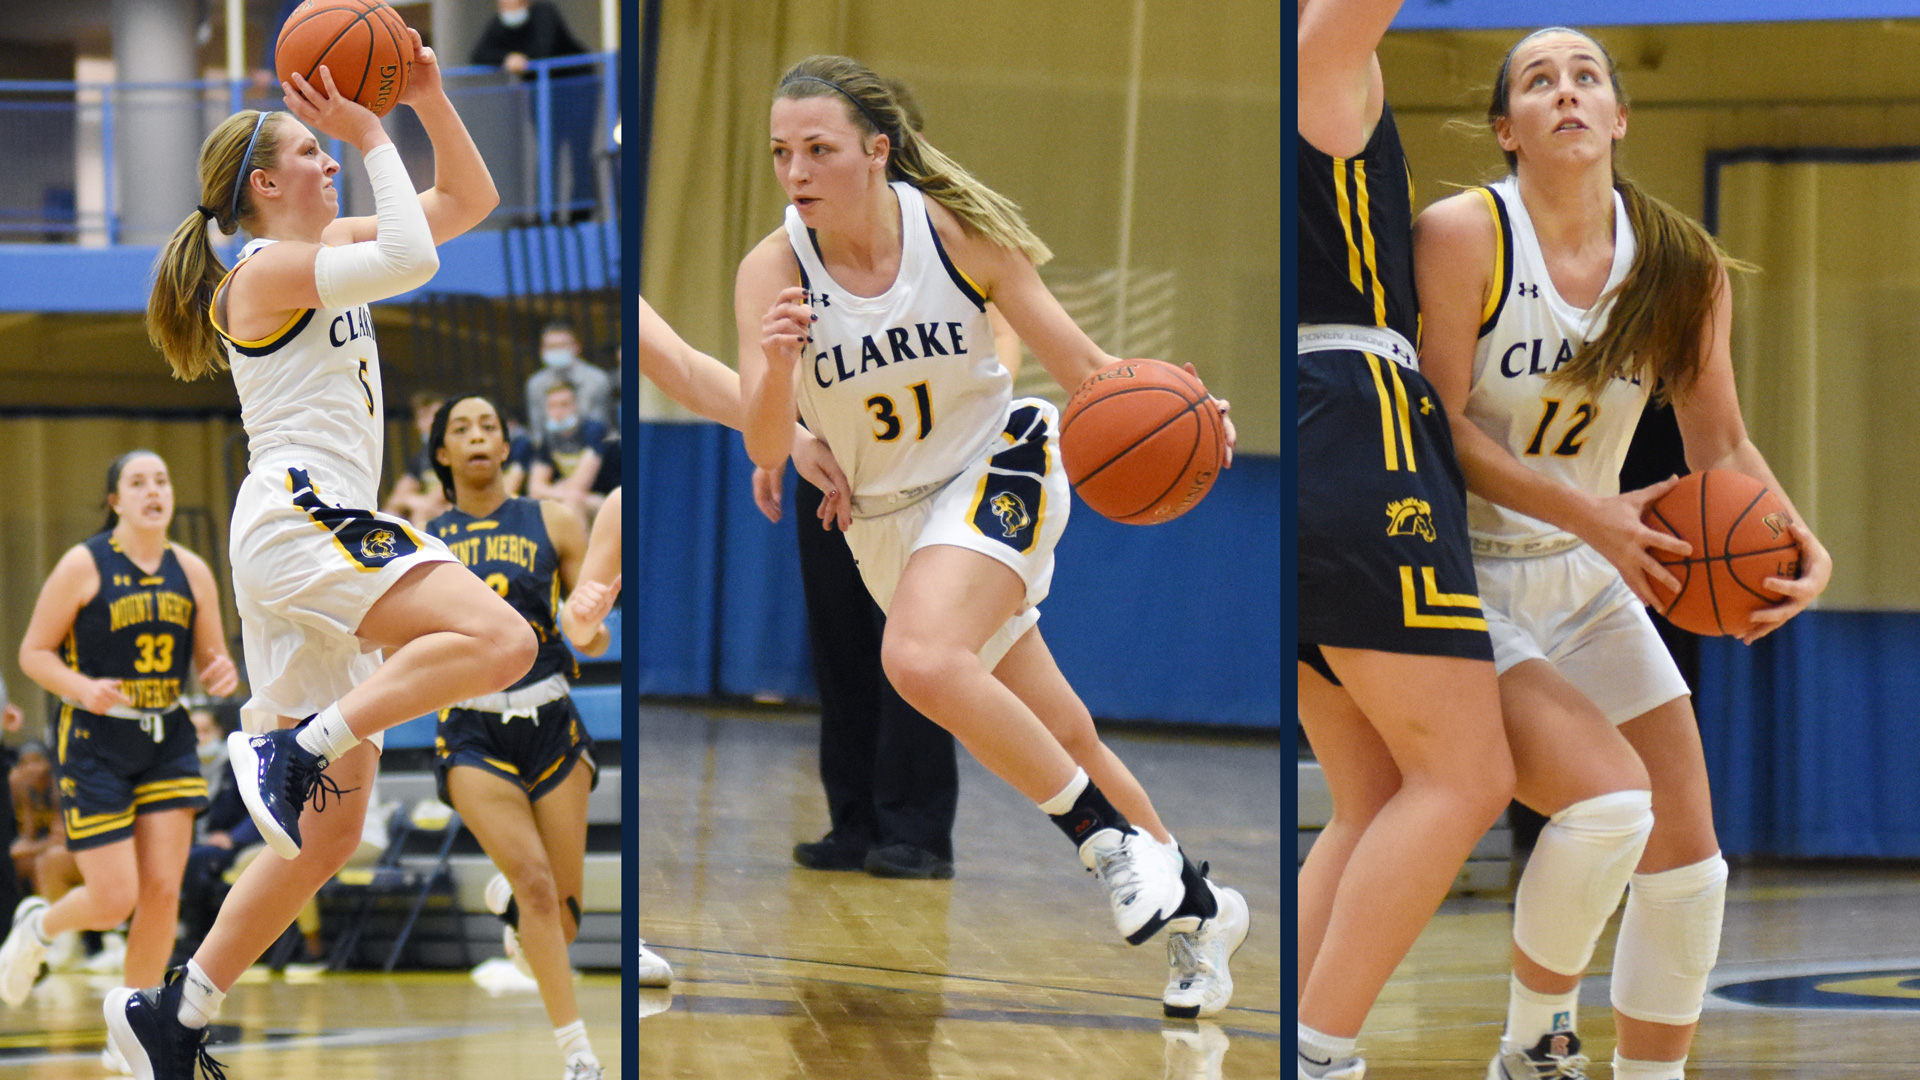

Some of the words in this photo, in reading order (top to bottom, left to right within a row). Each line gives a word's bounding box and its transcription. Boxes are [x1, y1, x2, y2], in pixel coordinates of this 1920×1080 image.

[814, 321, 968, 388] CLARKE
[358, 357, 375, 419] 5
[864, 378, 935, 443] 31
[1523, 397, 1601, 458] 12
[485, 534, 538, 573] MERCY
[109, 591, 154, 631] MOUNT
[134, 633, 175, 673] 33
